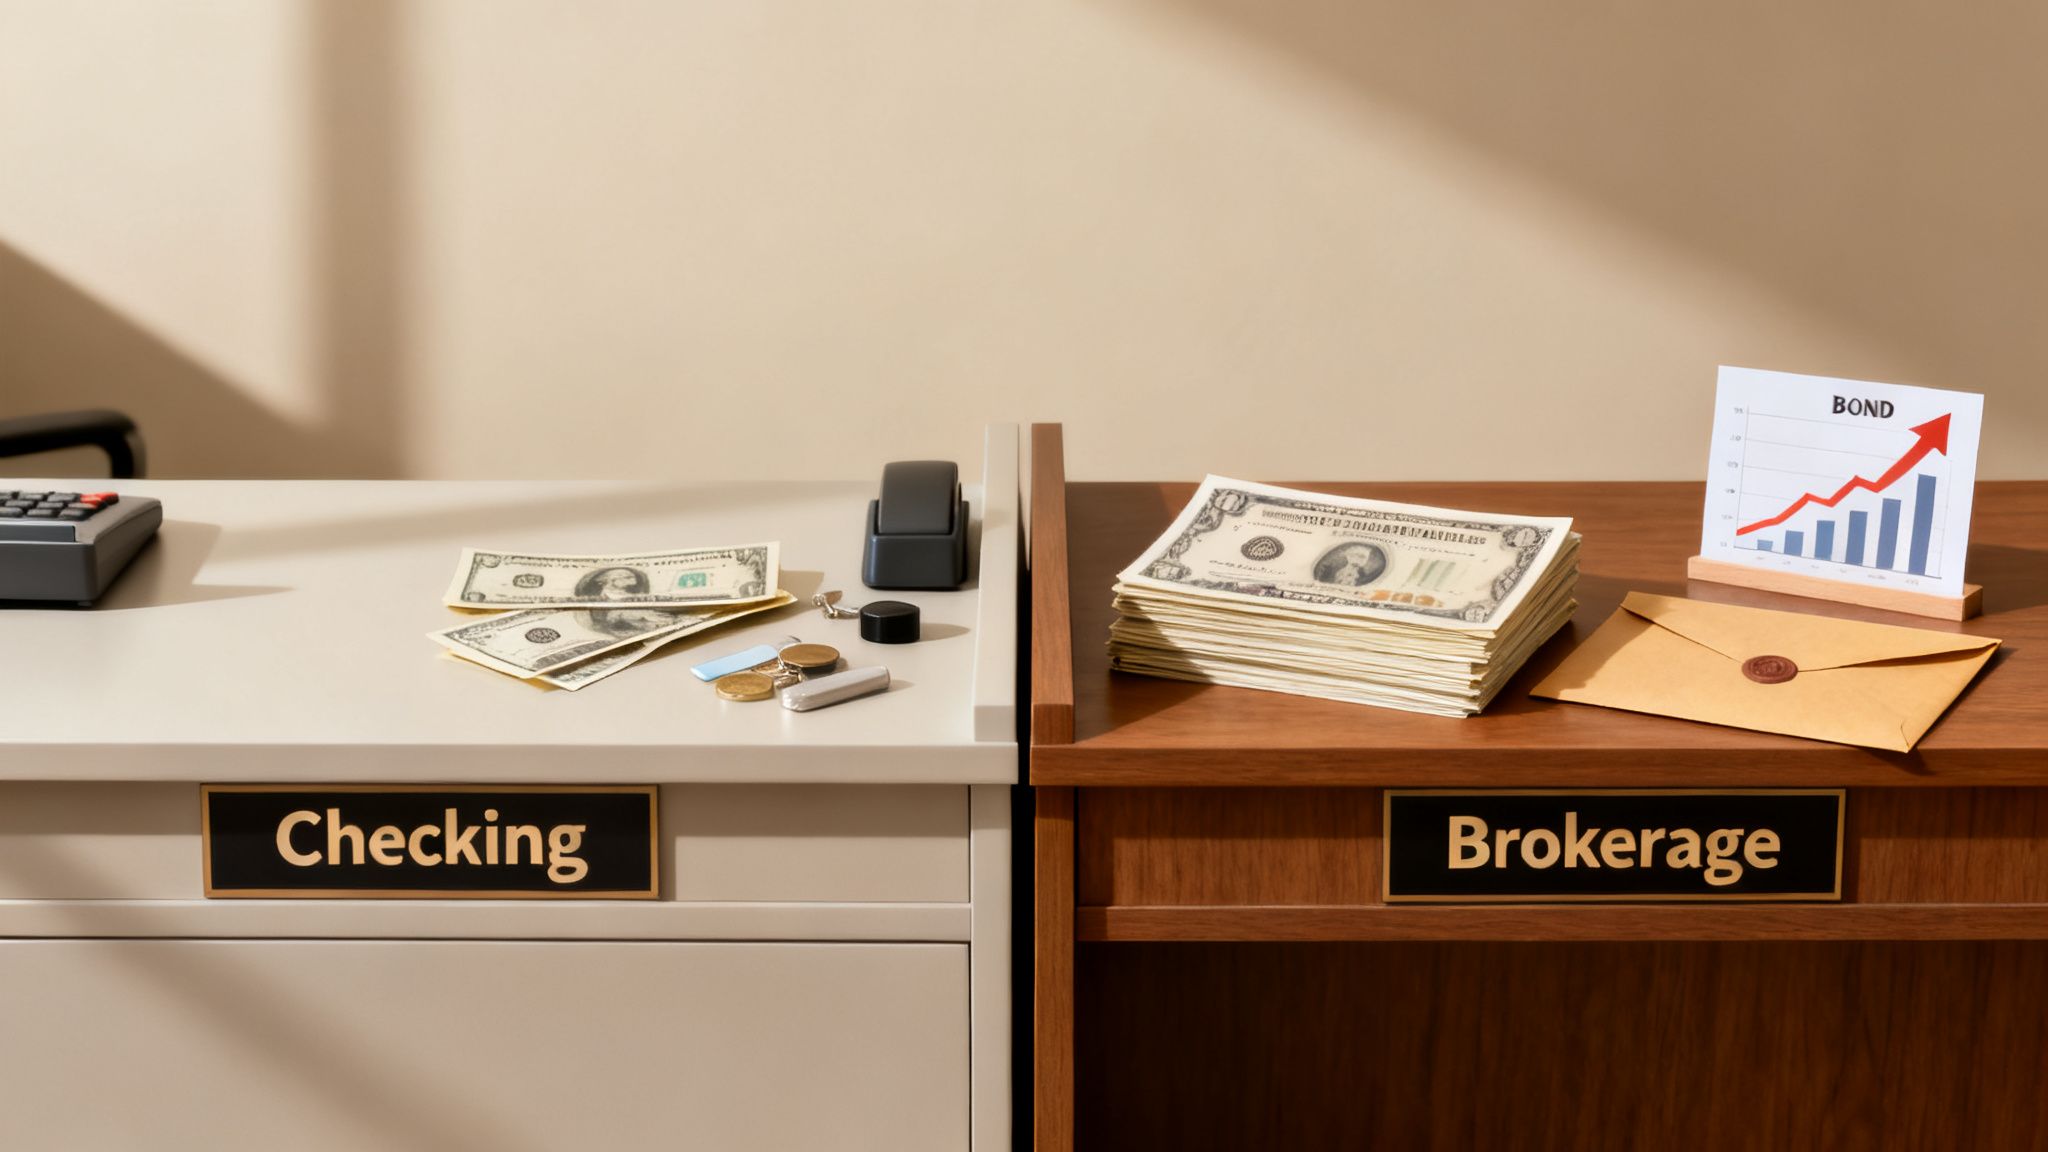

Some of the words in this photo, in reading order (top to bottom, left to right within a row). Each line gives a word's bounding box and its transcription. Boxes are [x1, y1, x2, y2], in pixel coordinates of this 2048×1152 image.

[1832, 395, 1894, 418] BOND
[276, 808, 588, 883] Checking
[1448, 811, 1780, 886] Brokerage
